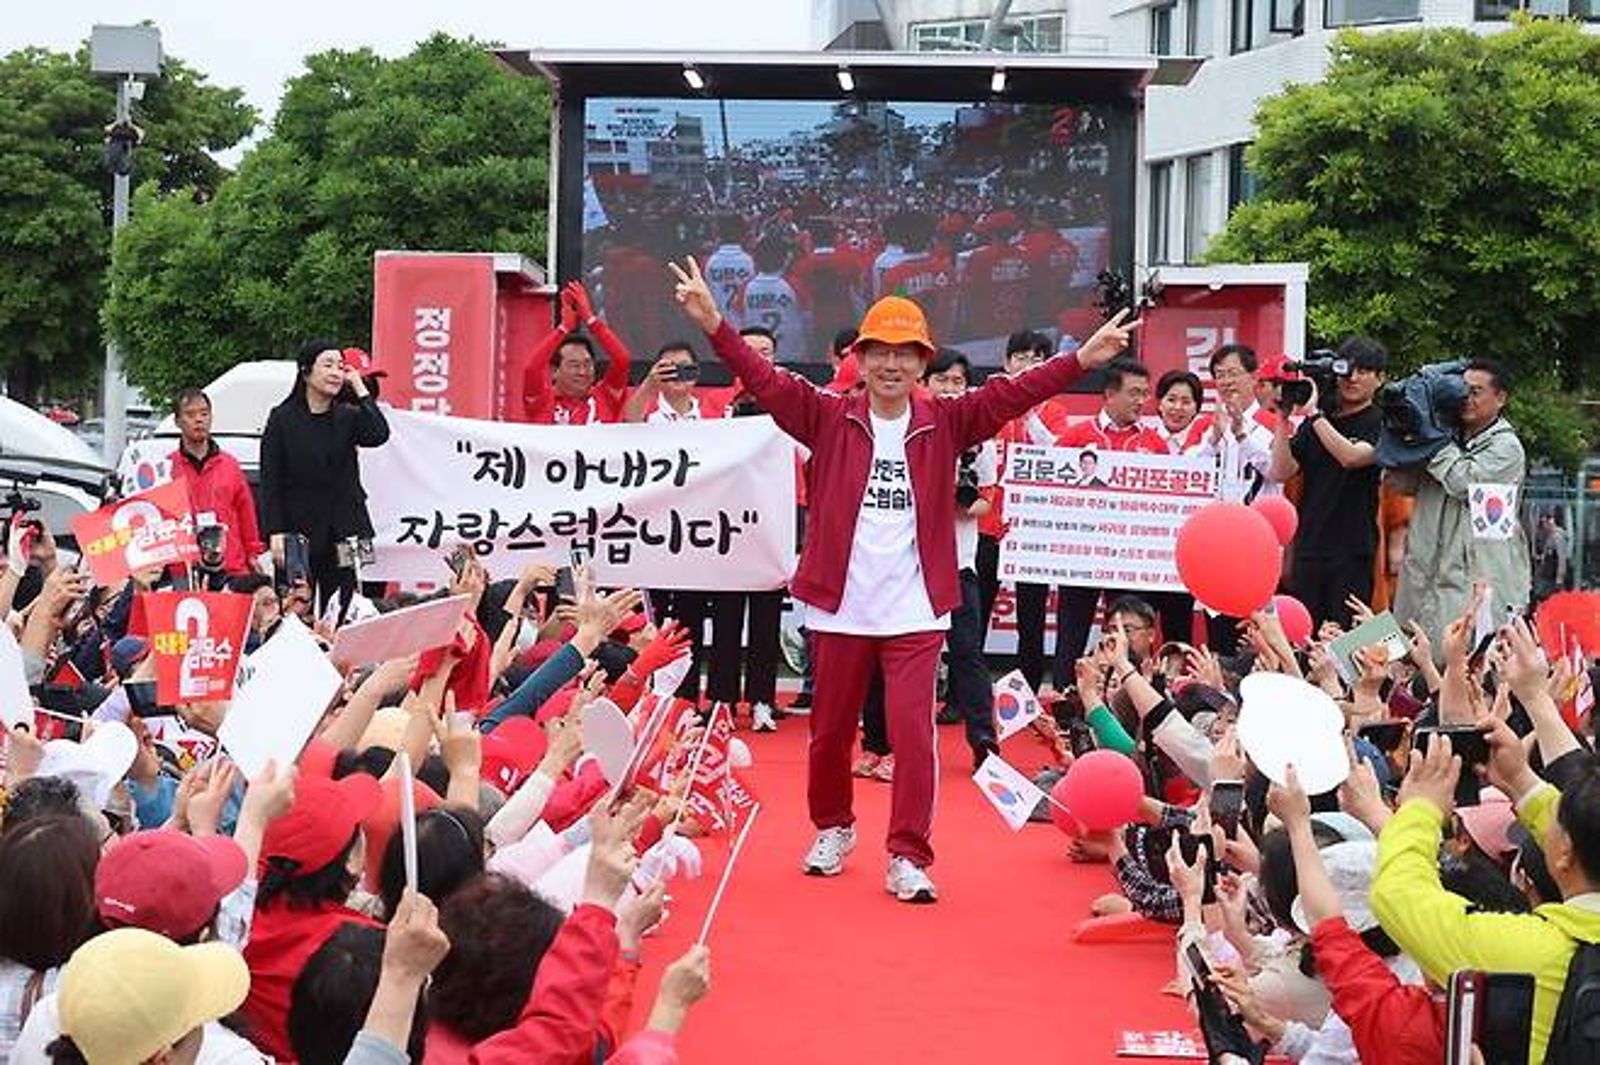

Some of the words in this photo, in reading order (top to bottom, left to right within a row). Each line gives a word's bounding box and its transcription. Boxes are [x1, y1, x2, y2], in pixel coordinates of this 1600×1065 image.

[456, 440, 526, 489] "제
[545, 447, 701, 491] 아내가
[1013, 458, 1077, 483] 김문수
[1107, 465, 1212, 492] 서귀포공약
[396, 503, 760, 565] 자랑스럽습니다"
[188, 637, 233, 669] 김문수
